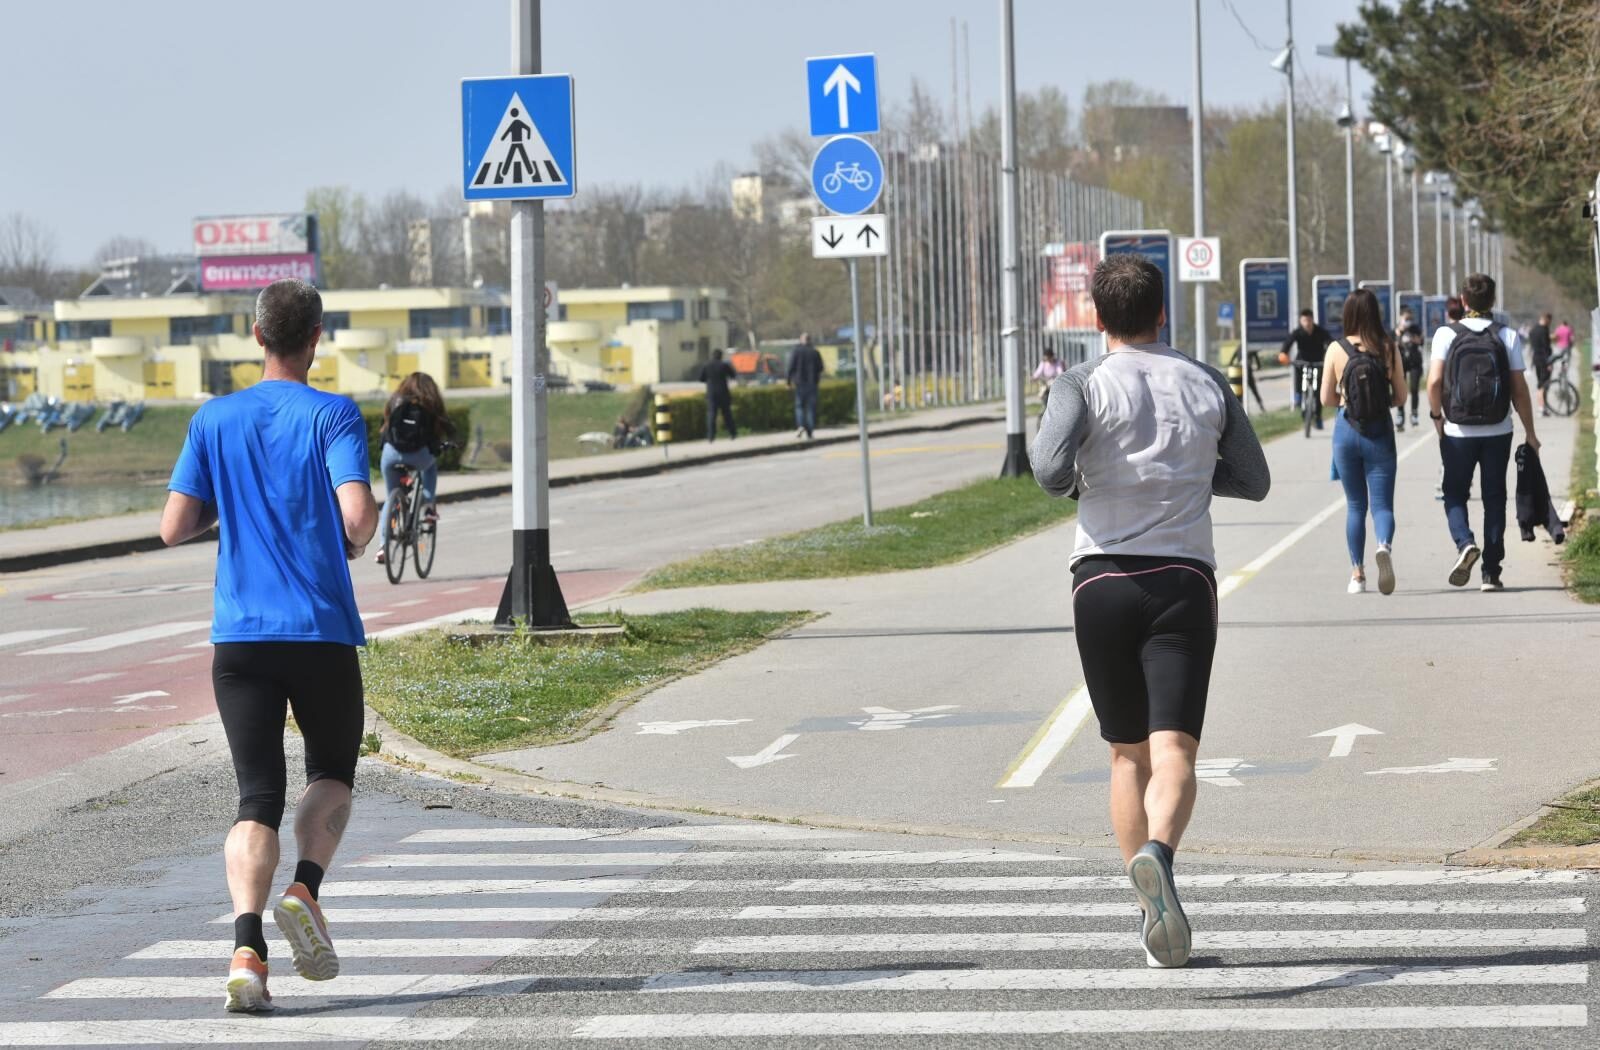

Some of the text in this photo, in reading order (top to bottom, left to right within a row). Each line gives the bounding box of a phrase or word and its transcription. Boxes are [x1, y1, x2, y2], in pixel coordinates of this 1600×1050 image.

[194, 221, 272, 246] OKI
[1192, 247, 1208, 262] 30
[204, 260, 312, 282] emmezeta
